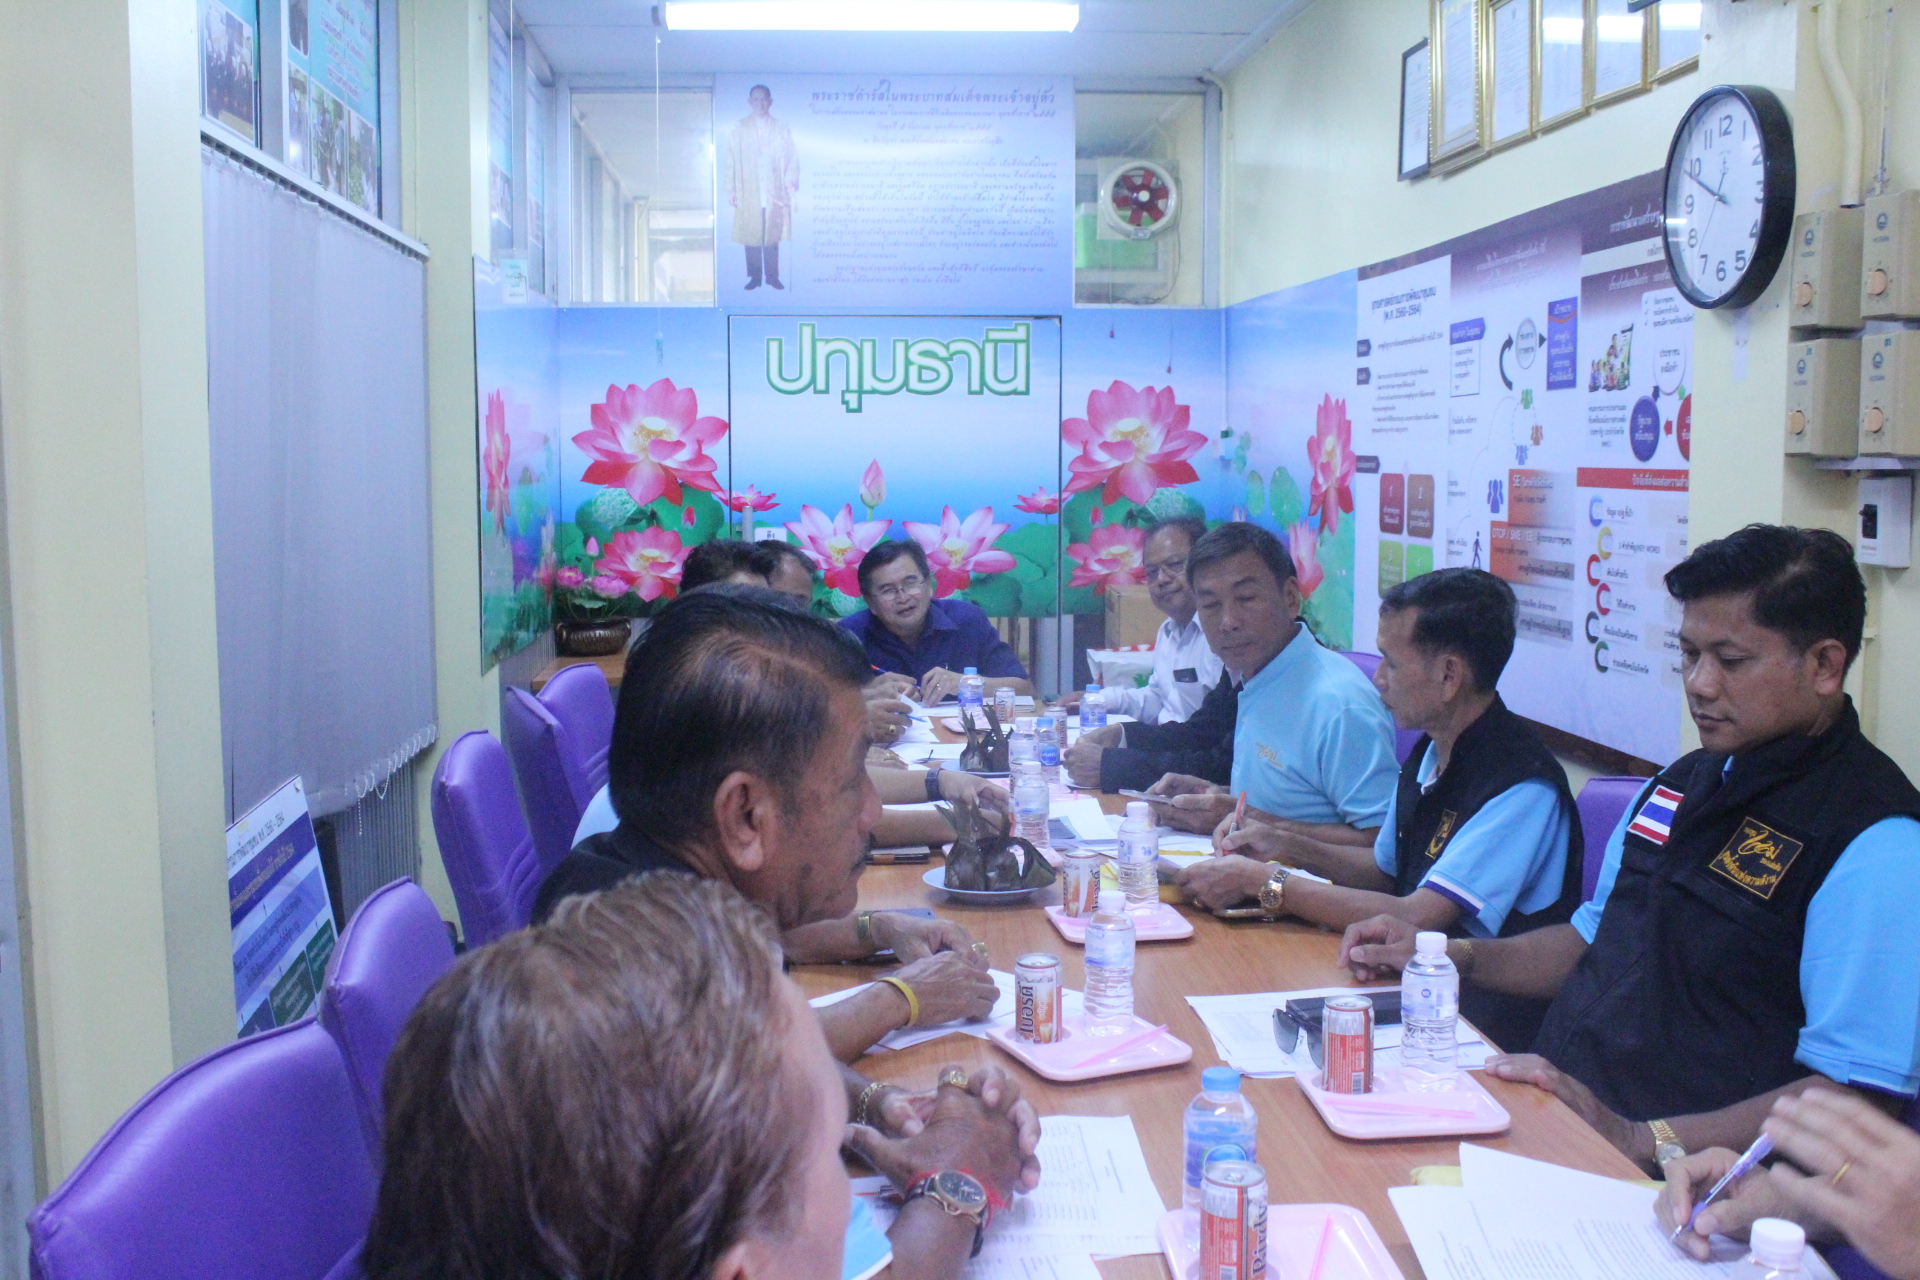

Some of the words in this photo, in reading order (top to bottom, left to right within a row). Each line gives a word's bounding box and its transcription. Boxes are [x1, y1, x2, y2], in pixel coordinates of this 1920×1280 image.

[811, 79, 1055, 110] พระราชดำรัสในพระบาทสมเด็จพระเจ้าอยู่หัว
[1719, 114, 1733, 138] 12
[1742, 120, 1747, 142] 1
[1703, 129, 1713, 150] 11
[1690, 157, 1702, 178] 10
[1684, 194, 1695, 216] 9
[1687, 228, 1698, 249] 8
[1699, 254, 1708, 275] 7
[1716, 260, 1726, 282] 6
[1734, 249, 1746, 272] 5
[766, 322, 1031, 413] ปทุมธานี
